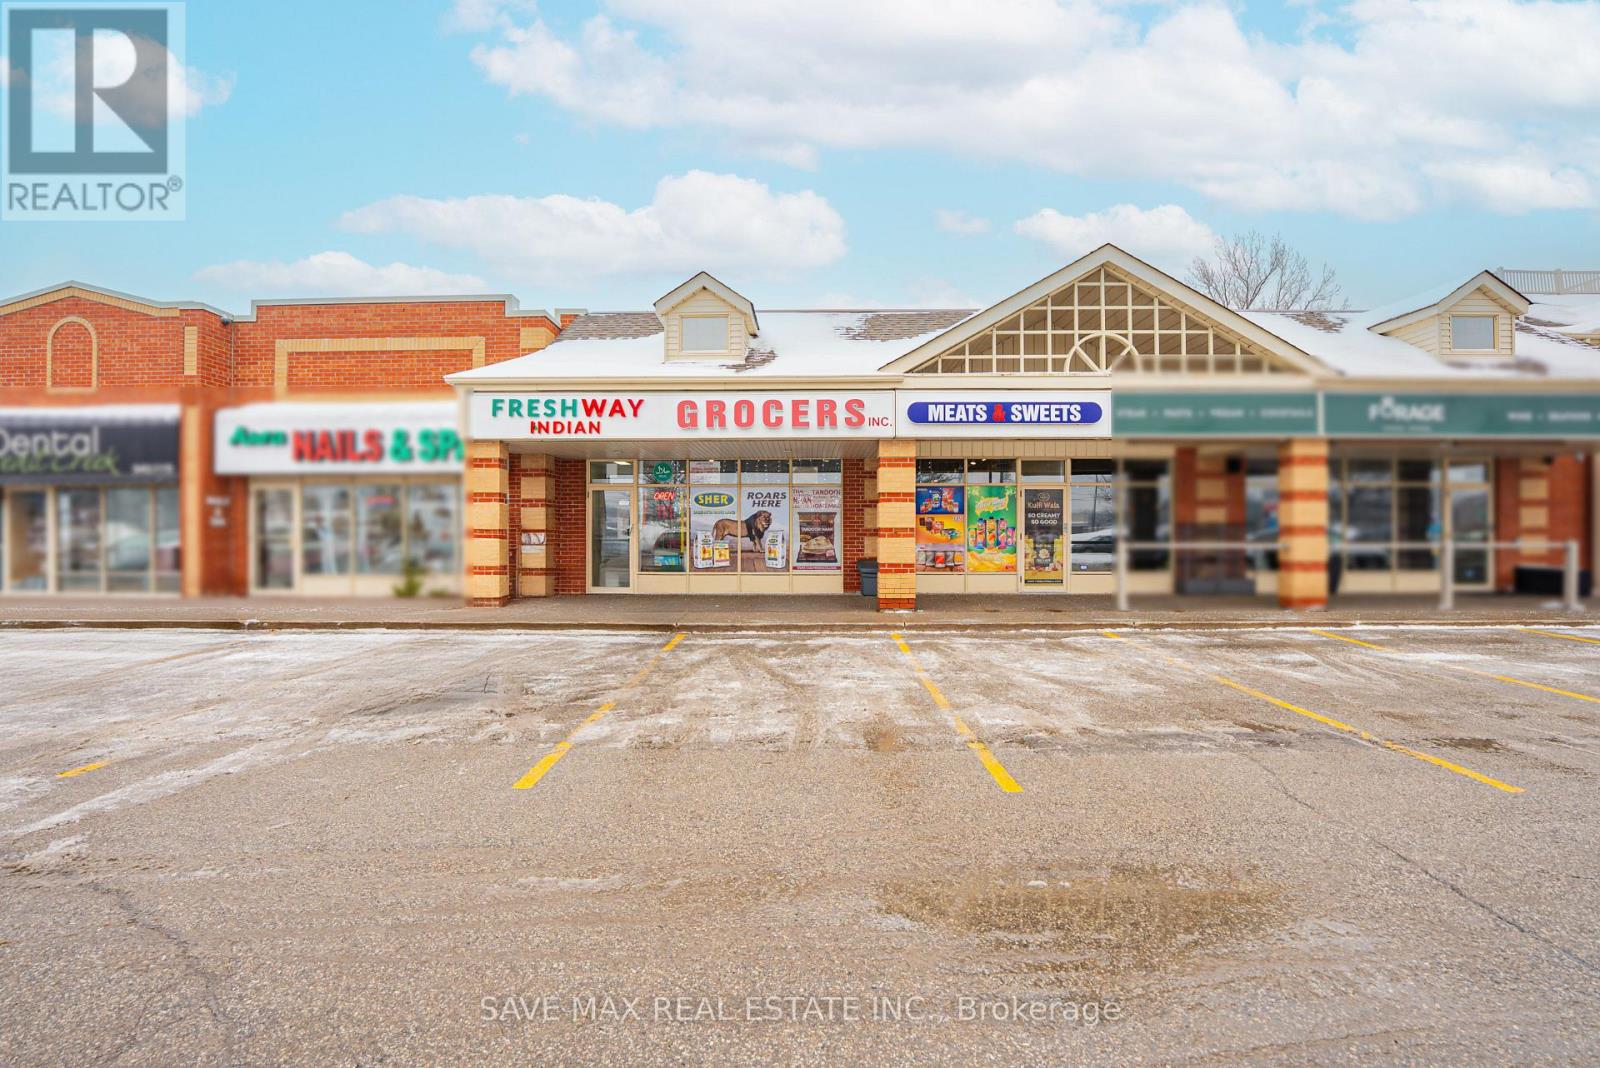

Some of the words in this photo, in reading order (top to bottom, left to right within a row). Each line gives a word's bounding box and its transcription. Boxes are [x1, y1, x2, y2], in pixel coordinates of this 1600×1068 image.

[491, 399, 645, 417] FRESHWAY
[676, 399, 866, 429] GROCERS
[868, 416, 893, 427] INC.
[927, 404, 988, 422] MEATS
[991, 404, 1006, 423] &
[1010, 404, 1082, 422] SWEETS
[530, 421, 601, 434] INDIAN
[292, 429, 384, 462] NAILS
[391, 428, 413, 462] &
[653, 491, 675, 500] OPEN
[698, 495, 729, 505] SHER
[747, 492, 787, 500] ROARS
